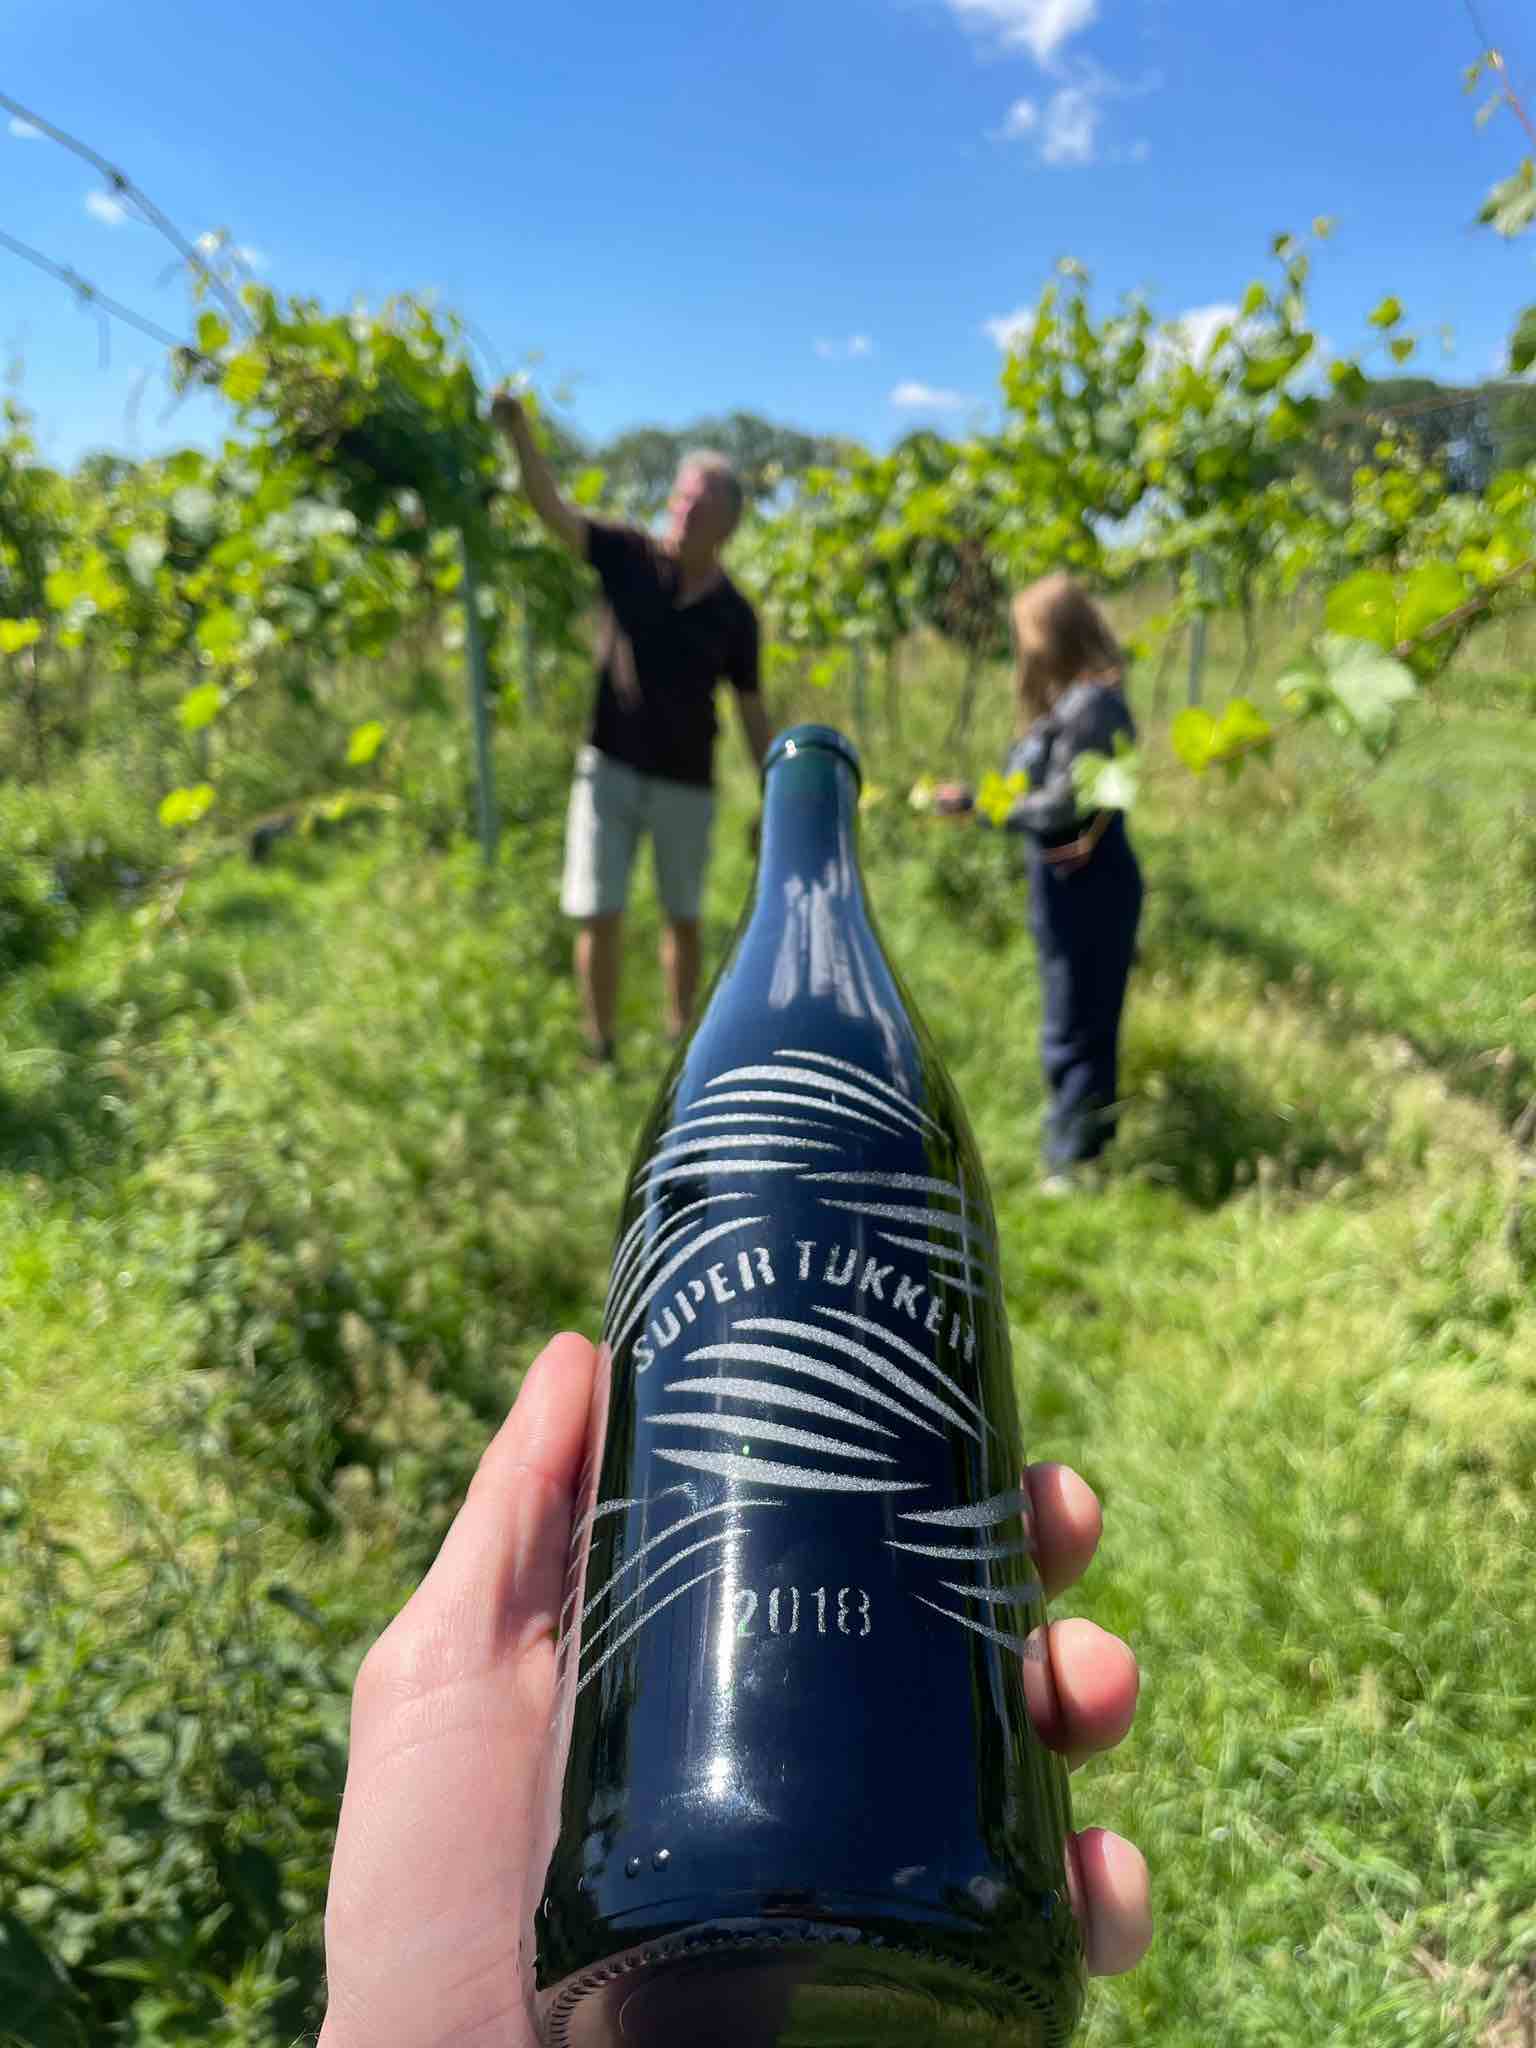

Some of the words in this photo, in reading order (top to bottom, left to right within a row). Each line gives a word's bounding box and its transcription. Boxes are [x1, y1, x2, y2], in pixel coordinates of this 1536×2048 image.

[632, 1246, 776, 1374] SUPER
[795, 1240, 976, 1363] TUKKER
[734, 1586, 872, 1637] 2018
